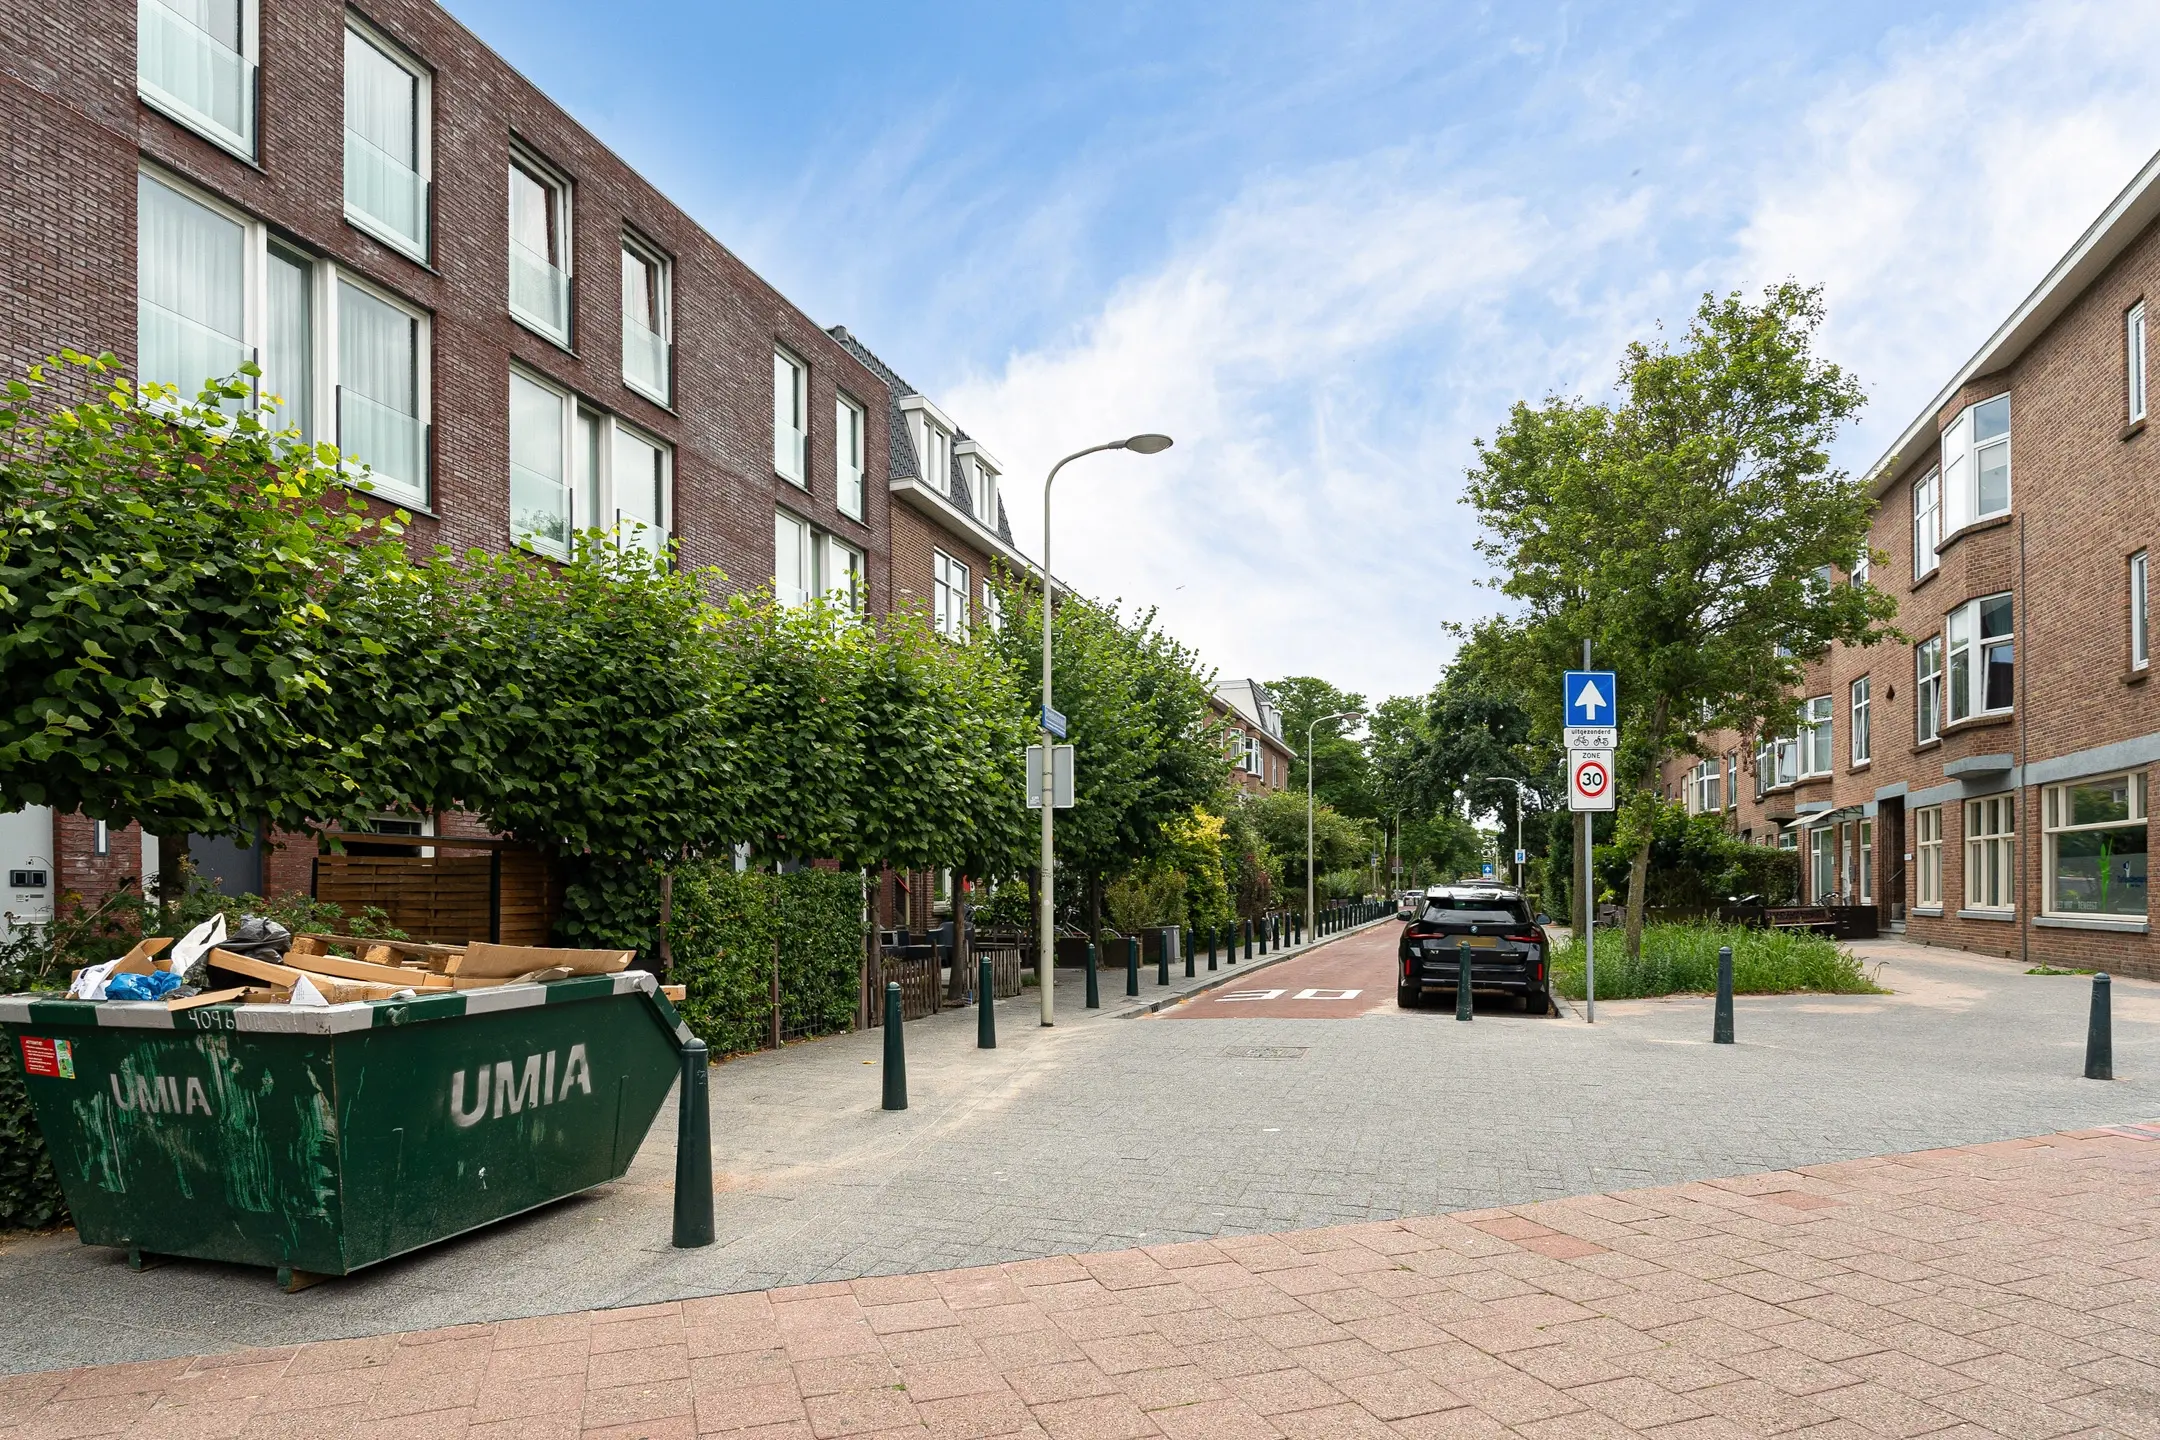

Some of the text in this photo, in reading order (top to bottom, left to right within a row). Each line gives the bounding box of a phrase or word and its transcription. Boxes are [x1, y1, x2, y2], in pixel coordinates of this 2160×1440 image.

[1582, 772, 1603, 786] 30
[187, 1010, 235, 1030] 4096
[110, 1073, 213, 1116] UMIA
[451, 1043, 592, 1128] UMIA
